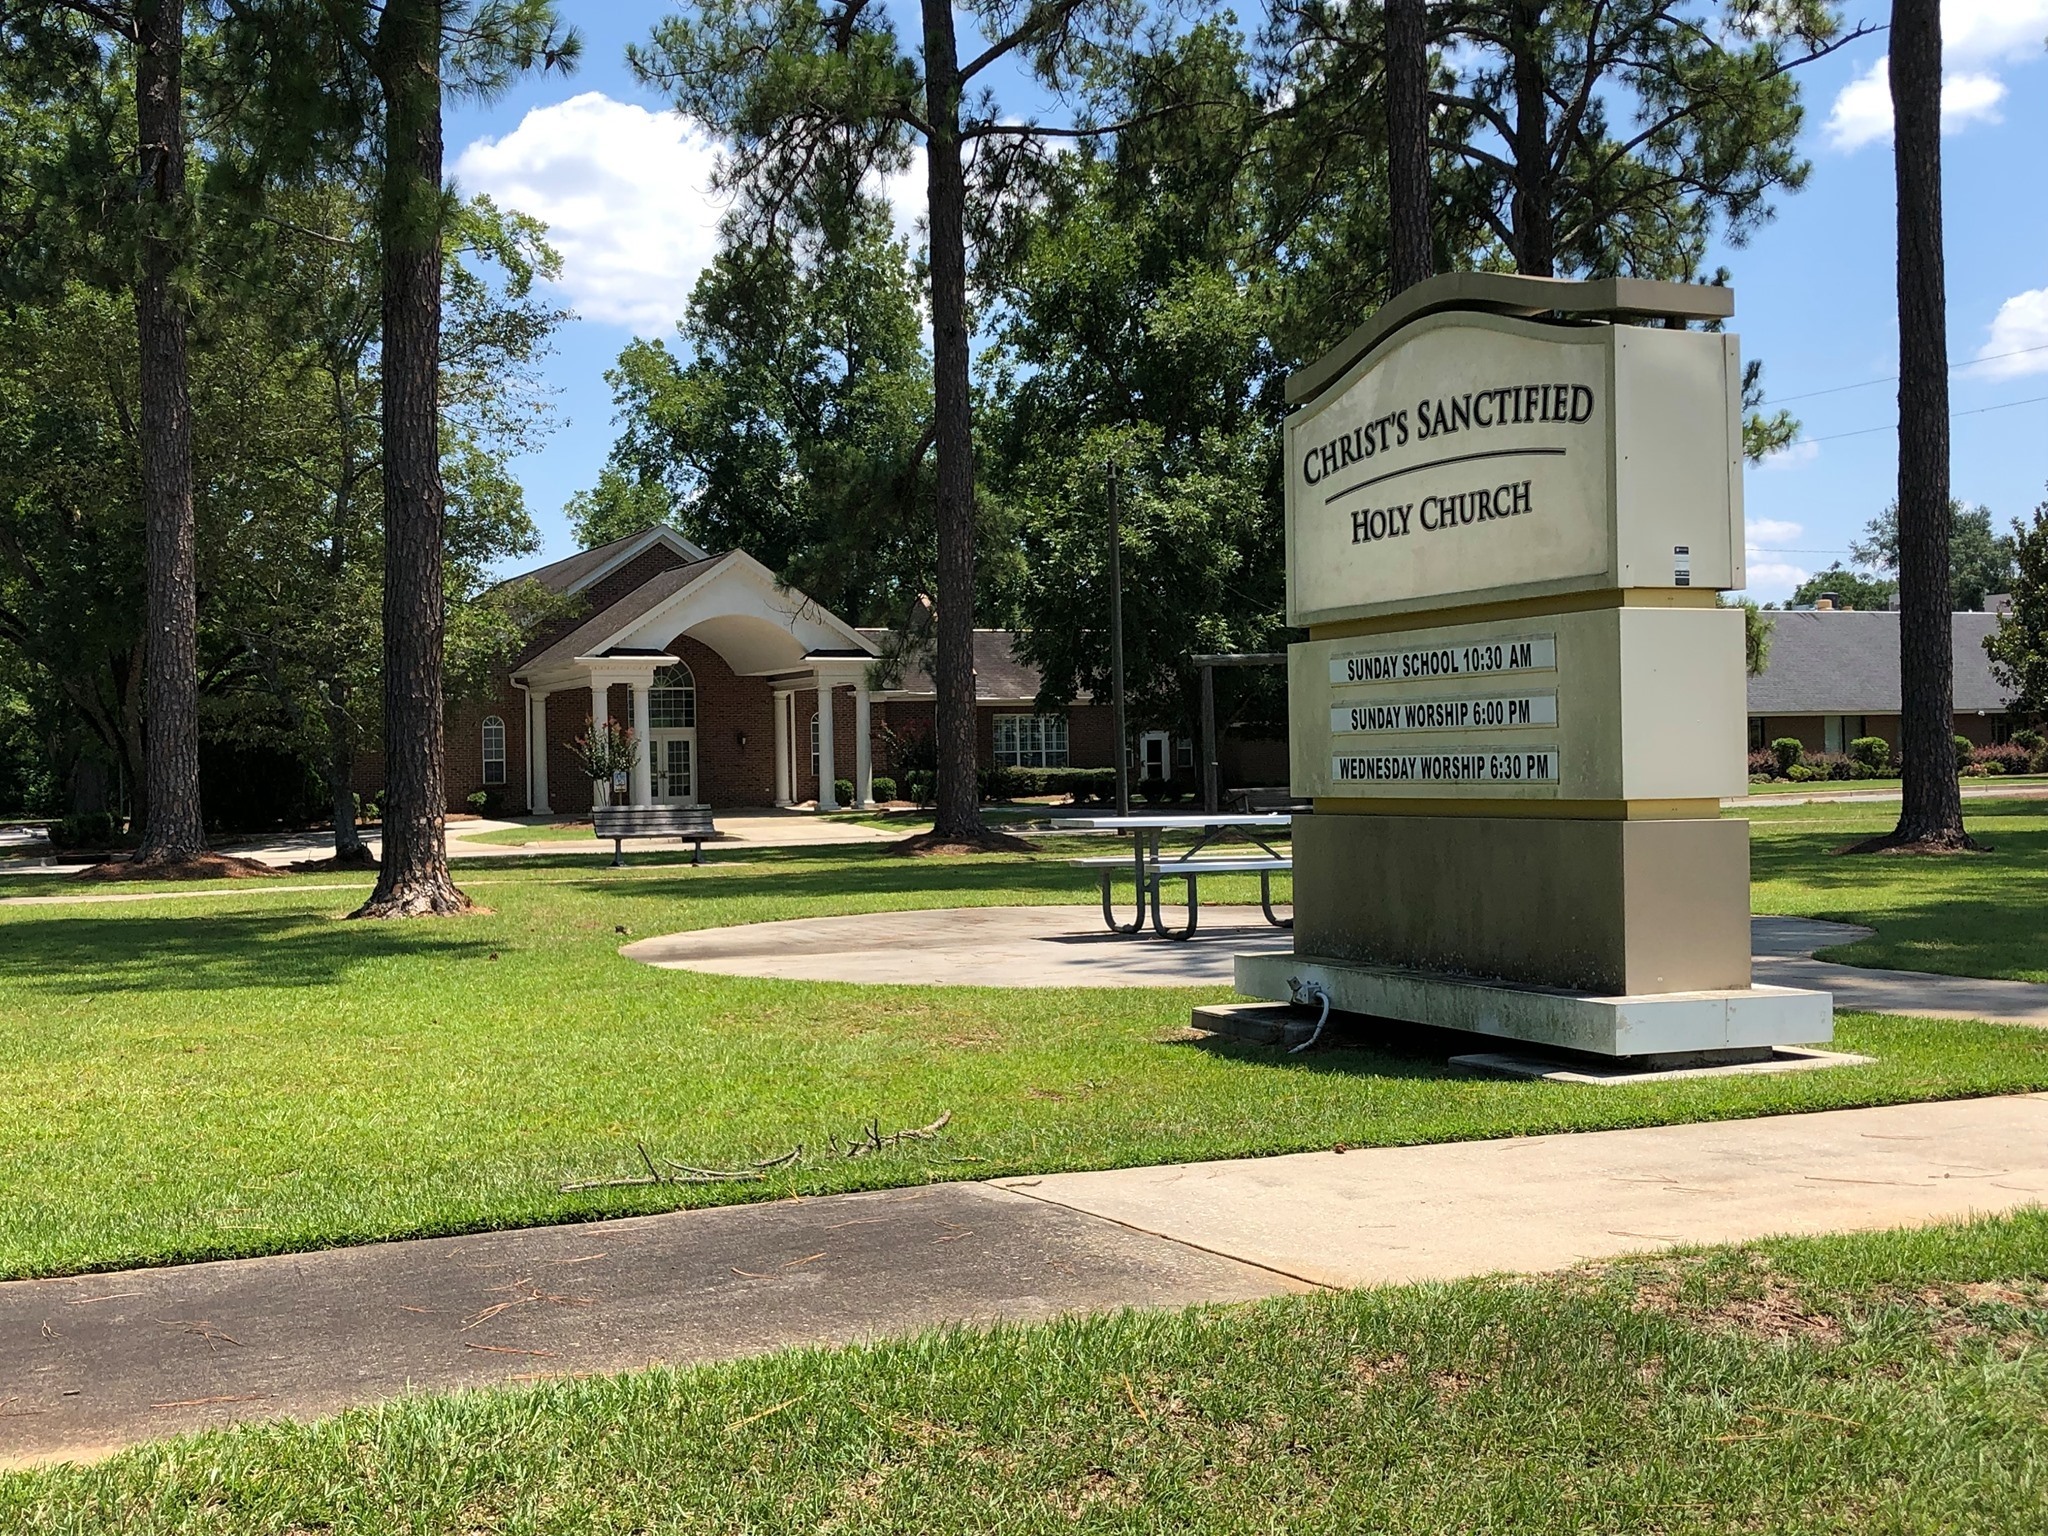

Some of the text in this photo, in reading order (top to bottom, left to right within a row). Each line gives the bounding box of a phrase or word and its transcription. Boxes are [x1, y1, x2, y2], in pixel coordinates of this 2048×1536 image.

[1303, 384, 1594, 486] CHRIST'S SANCTIFIED
[1351, 480, 1532, 545] HOLY CHURCH
[1347, 643, 1532, 681] SUNDAY SCHOOL 10:30 AM
[1351, 699, 1530, 731] SUNDAY WORSHIP 6:00 PM
[1339, 754, 1549, 780] WEDNESDAY WORSHIP 6:30 PM
